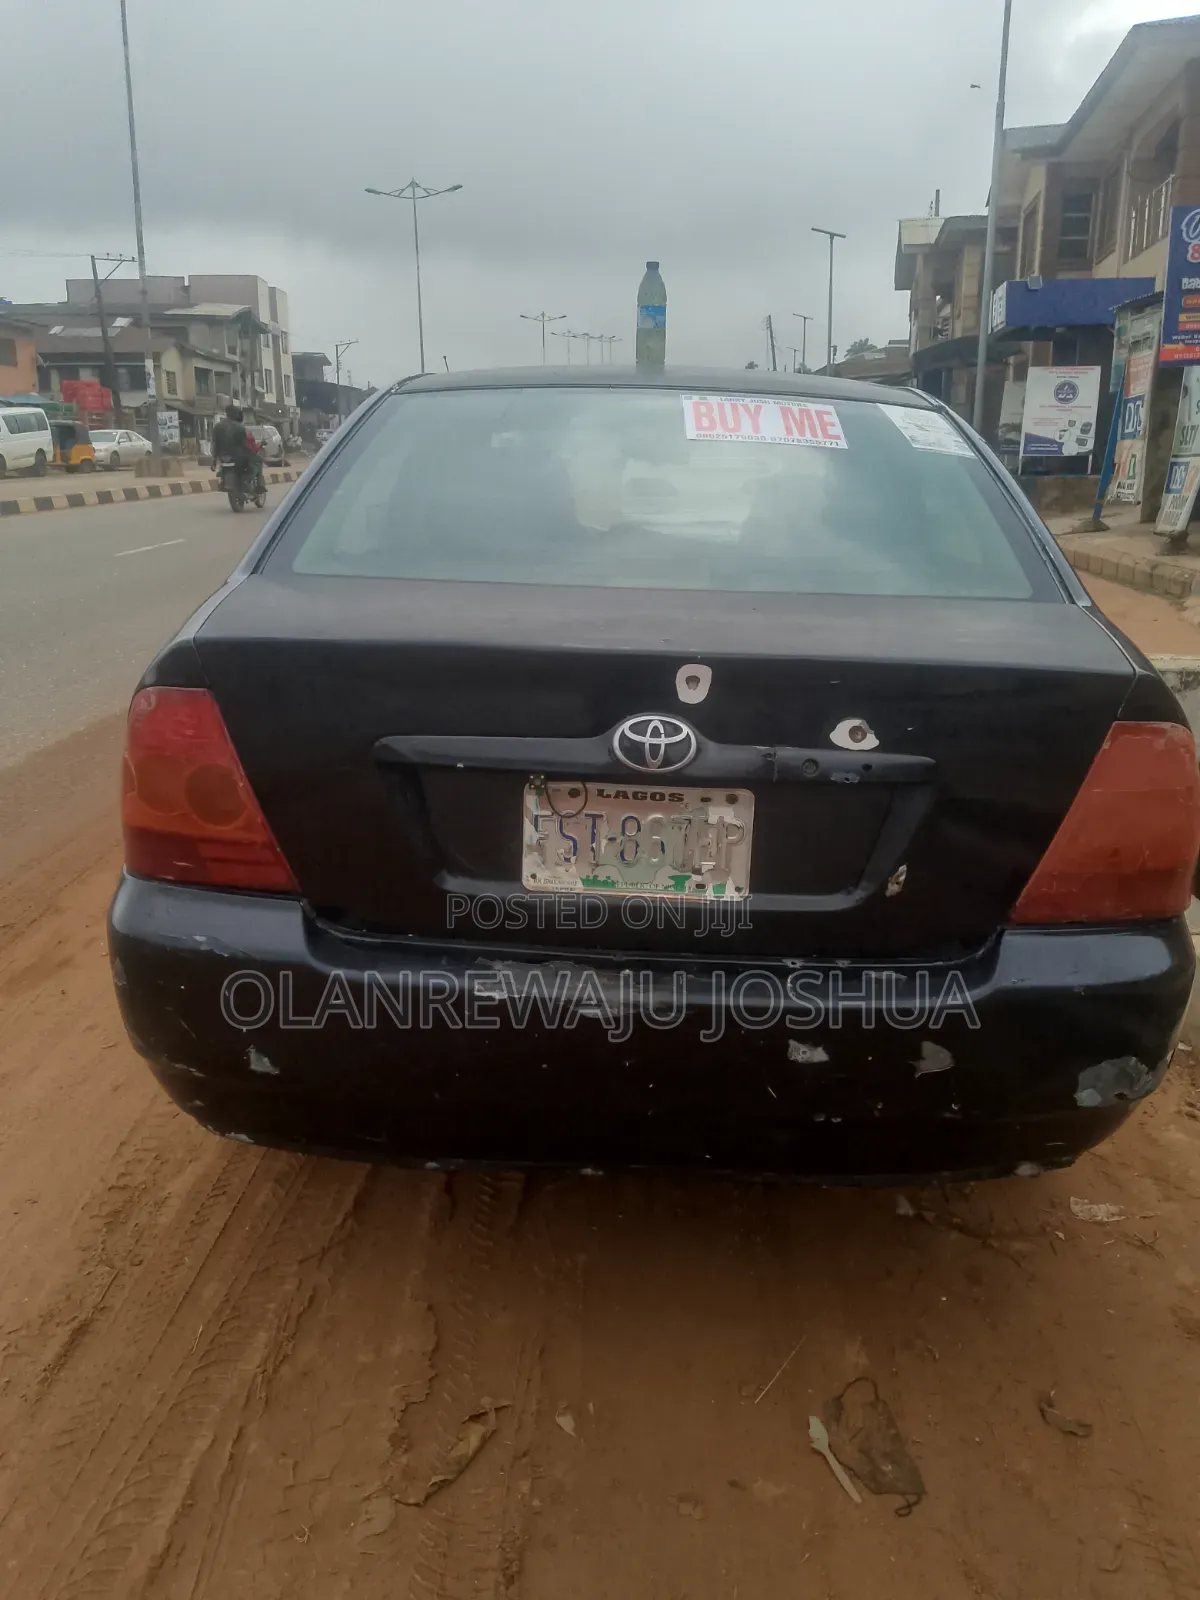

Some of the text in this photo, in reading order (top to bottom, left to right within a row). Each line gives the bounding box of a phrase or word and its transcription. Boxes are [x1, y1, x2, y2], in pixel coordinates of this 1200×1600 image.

[692, 400, 841, 440] BUY ME
[596, 788, 685, 803] LAGOS
